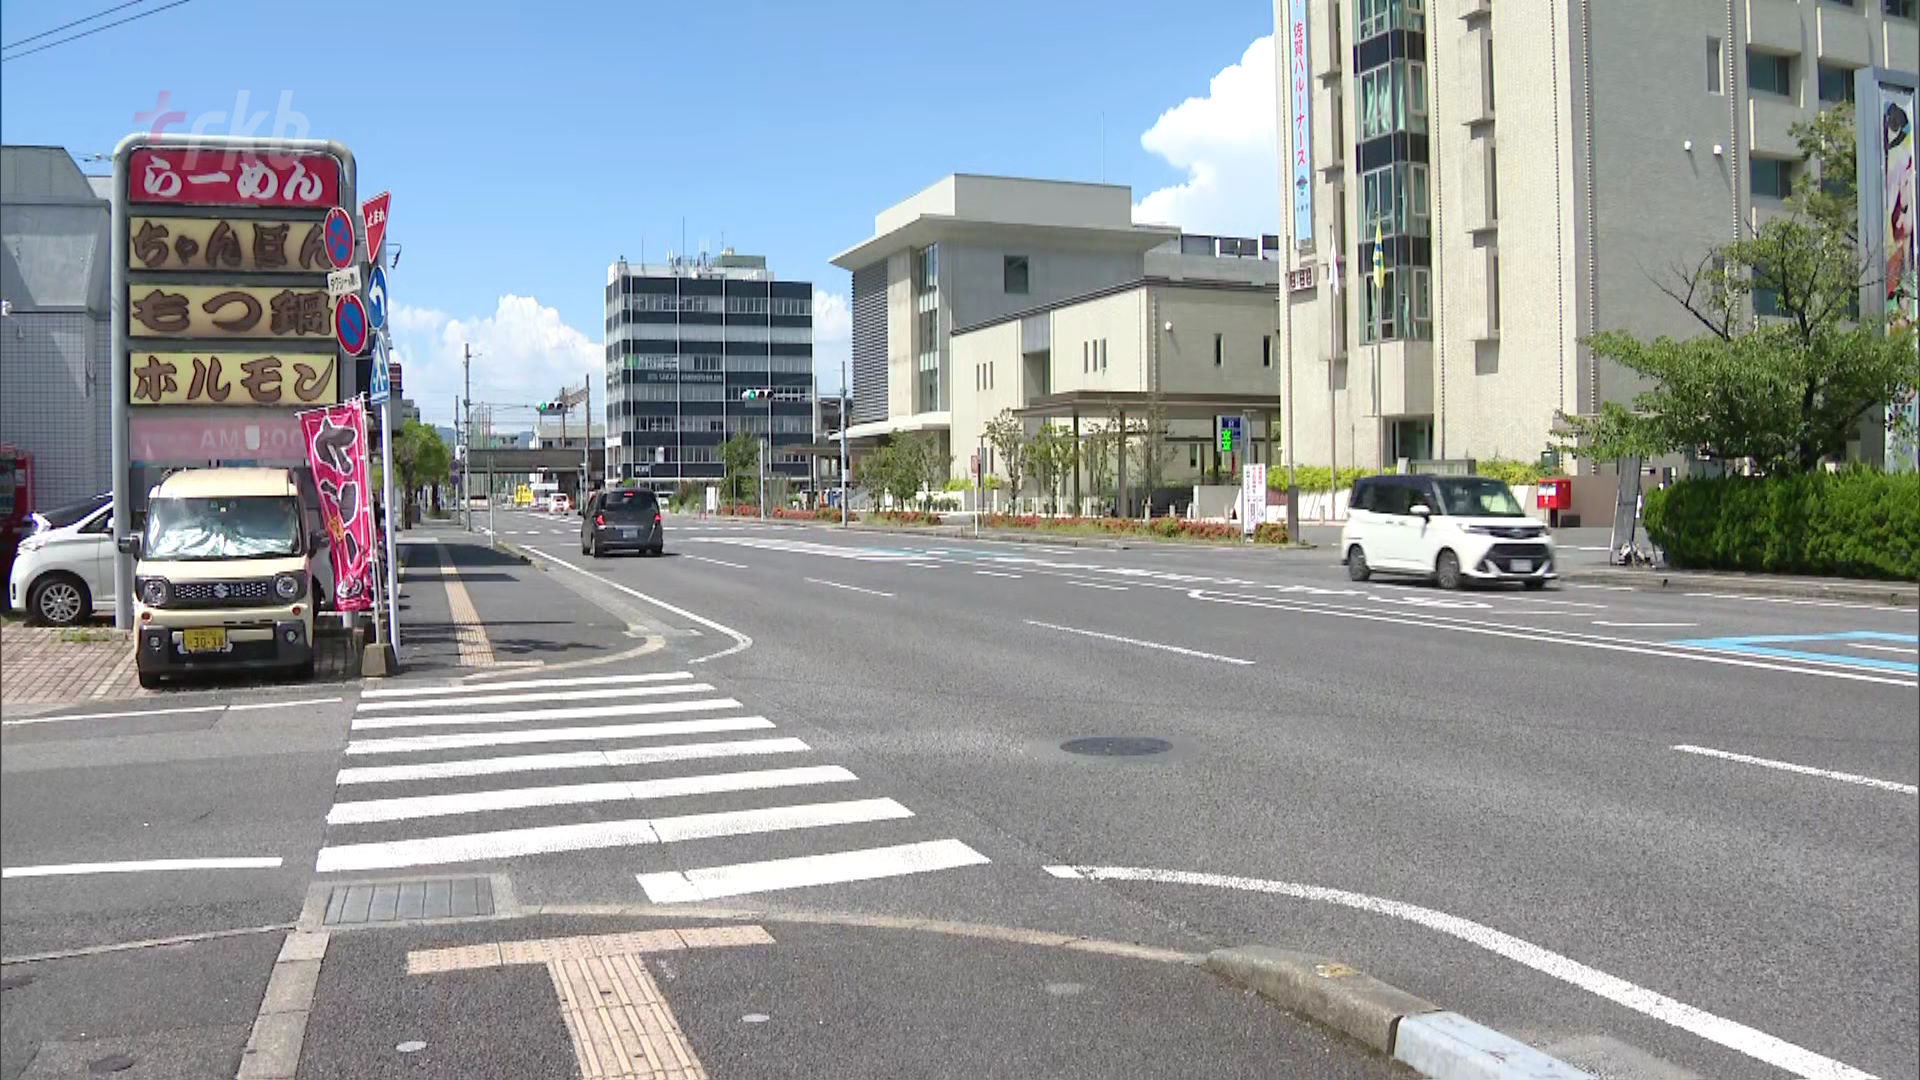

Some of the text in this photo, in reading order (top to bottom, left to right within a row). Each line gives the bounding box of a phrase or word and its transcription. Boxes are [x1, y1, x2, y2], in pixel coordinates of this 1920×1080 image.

[144, 156, 323, 200] らーめん
[367, 208, 385, 228] 止まれ
[133, 288, 331, 336] もつ鍋
[133, 355, 334, 402] ホルモン
[201, 429, 239, 448] AM
